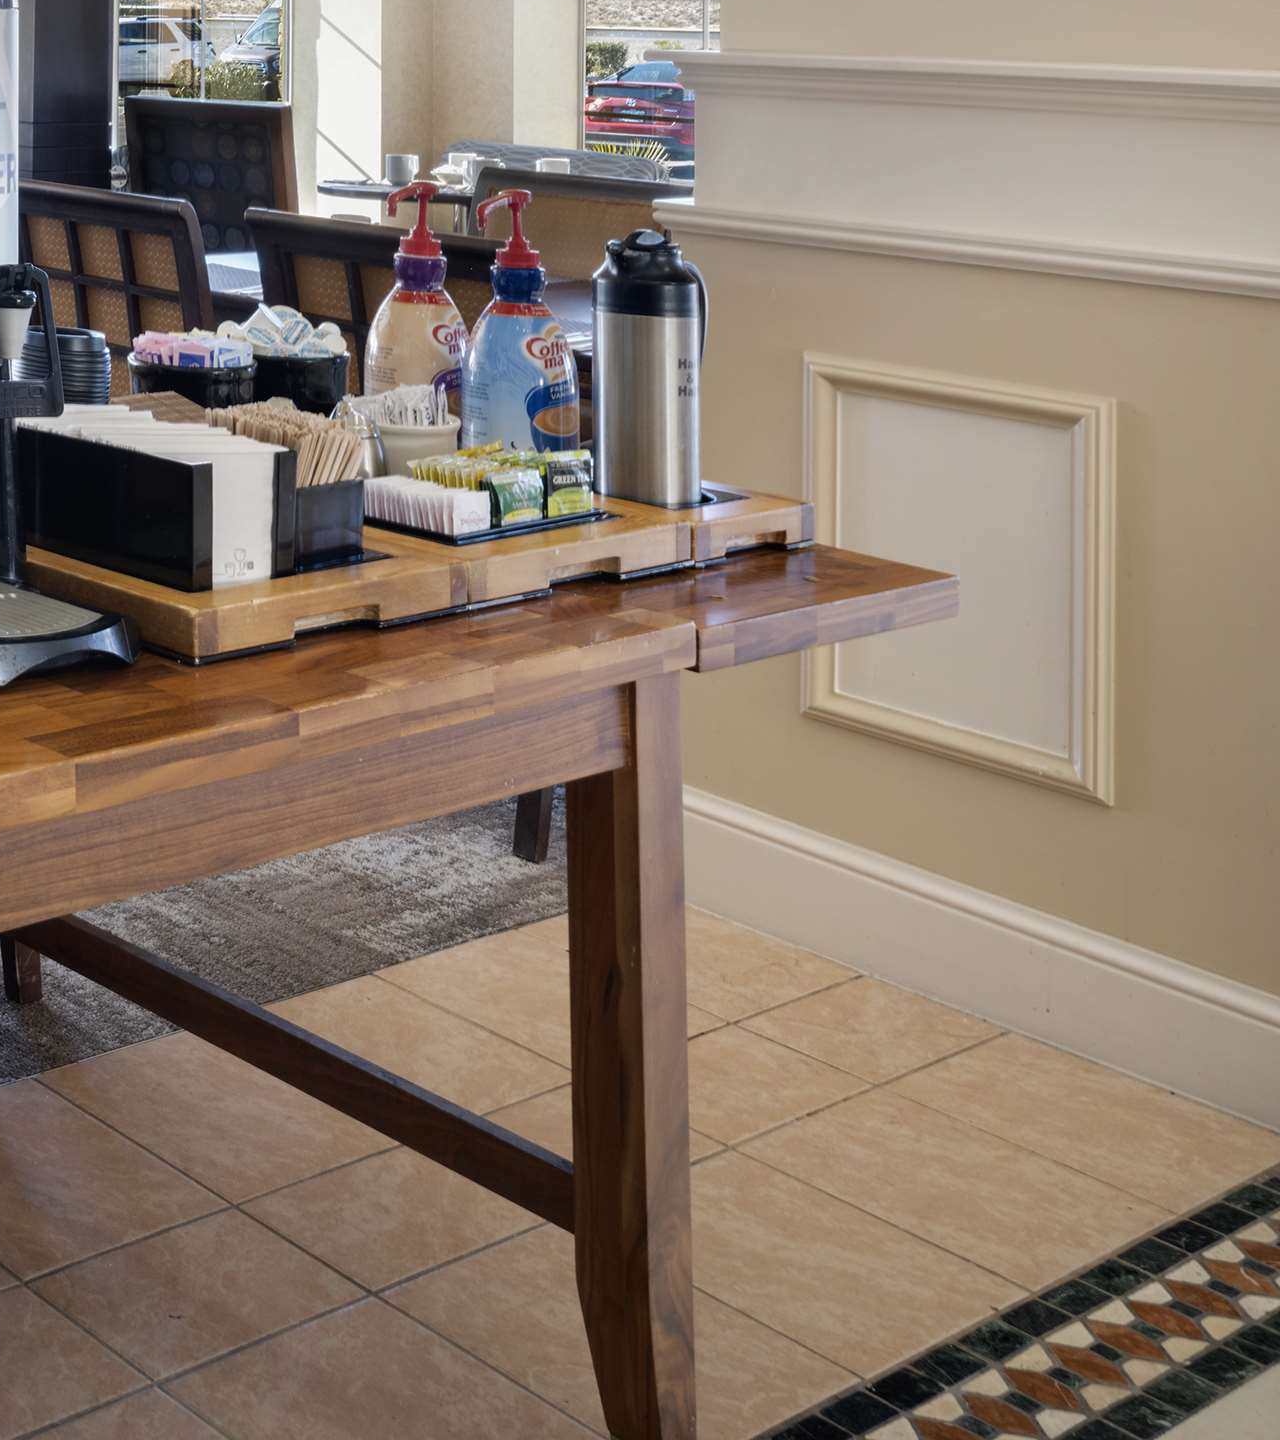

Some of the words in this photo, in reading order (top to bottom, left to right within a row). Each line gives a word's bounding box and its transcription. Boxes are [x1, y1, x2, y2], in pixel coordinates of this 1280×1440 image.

[543, 355, 565, 370] ma
[678, 358, 694, 369] Ha
[678, 386, 694, 397] Ha
